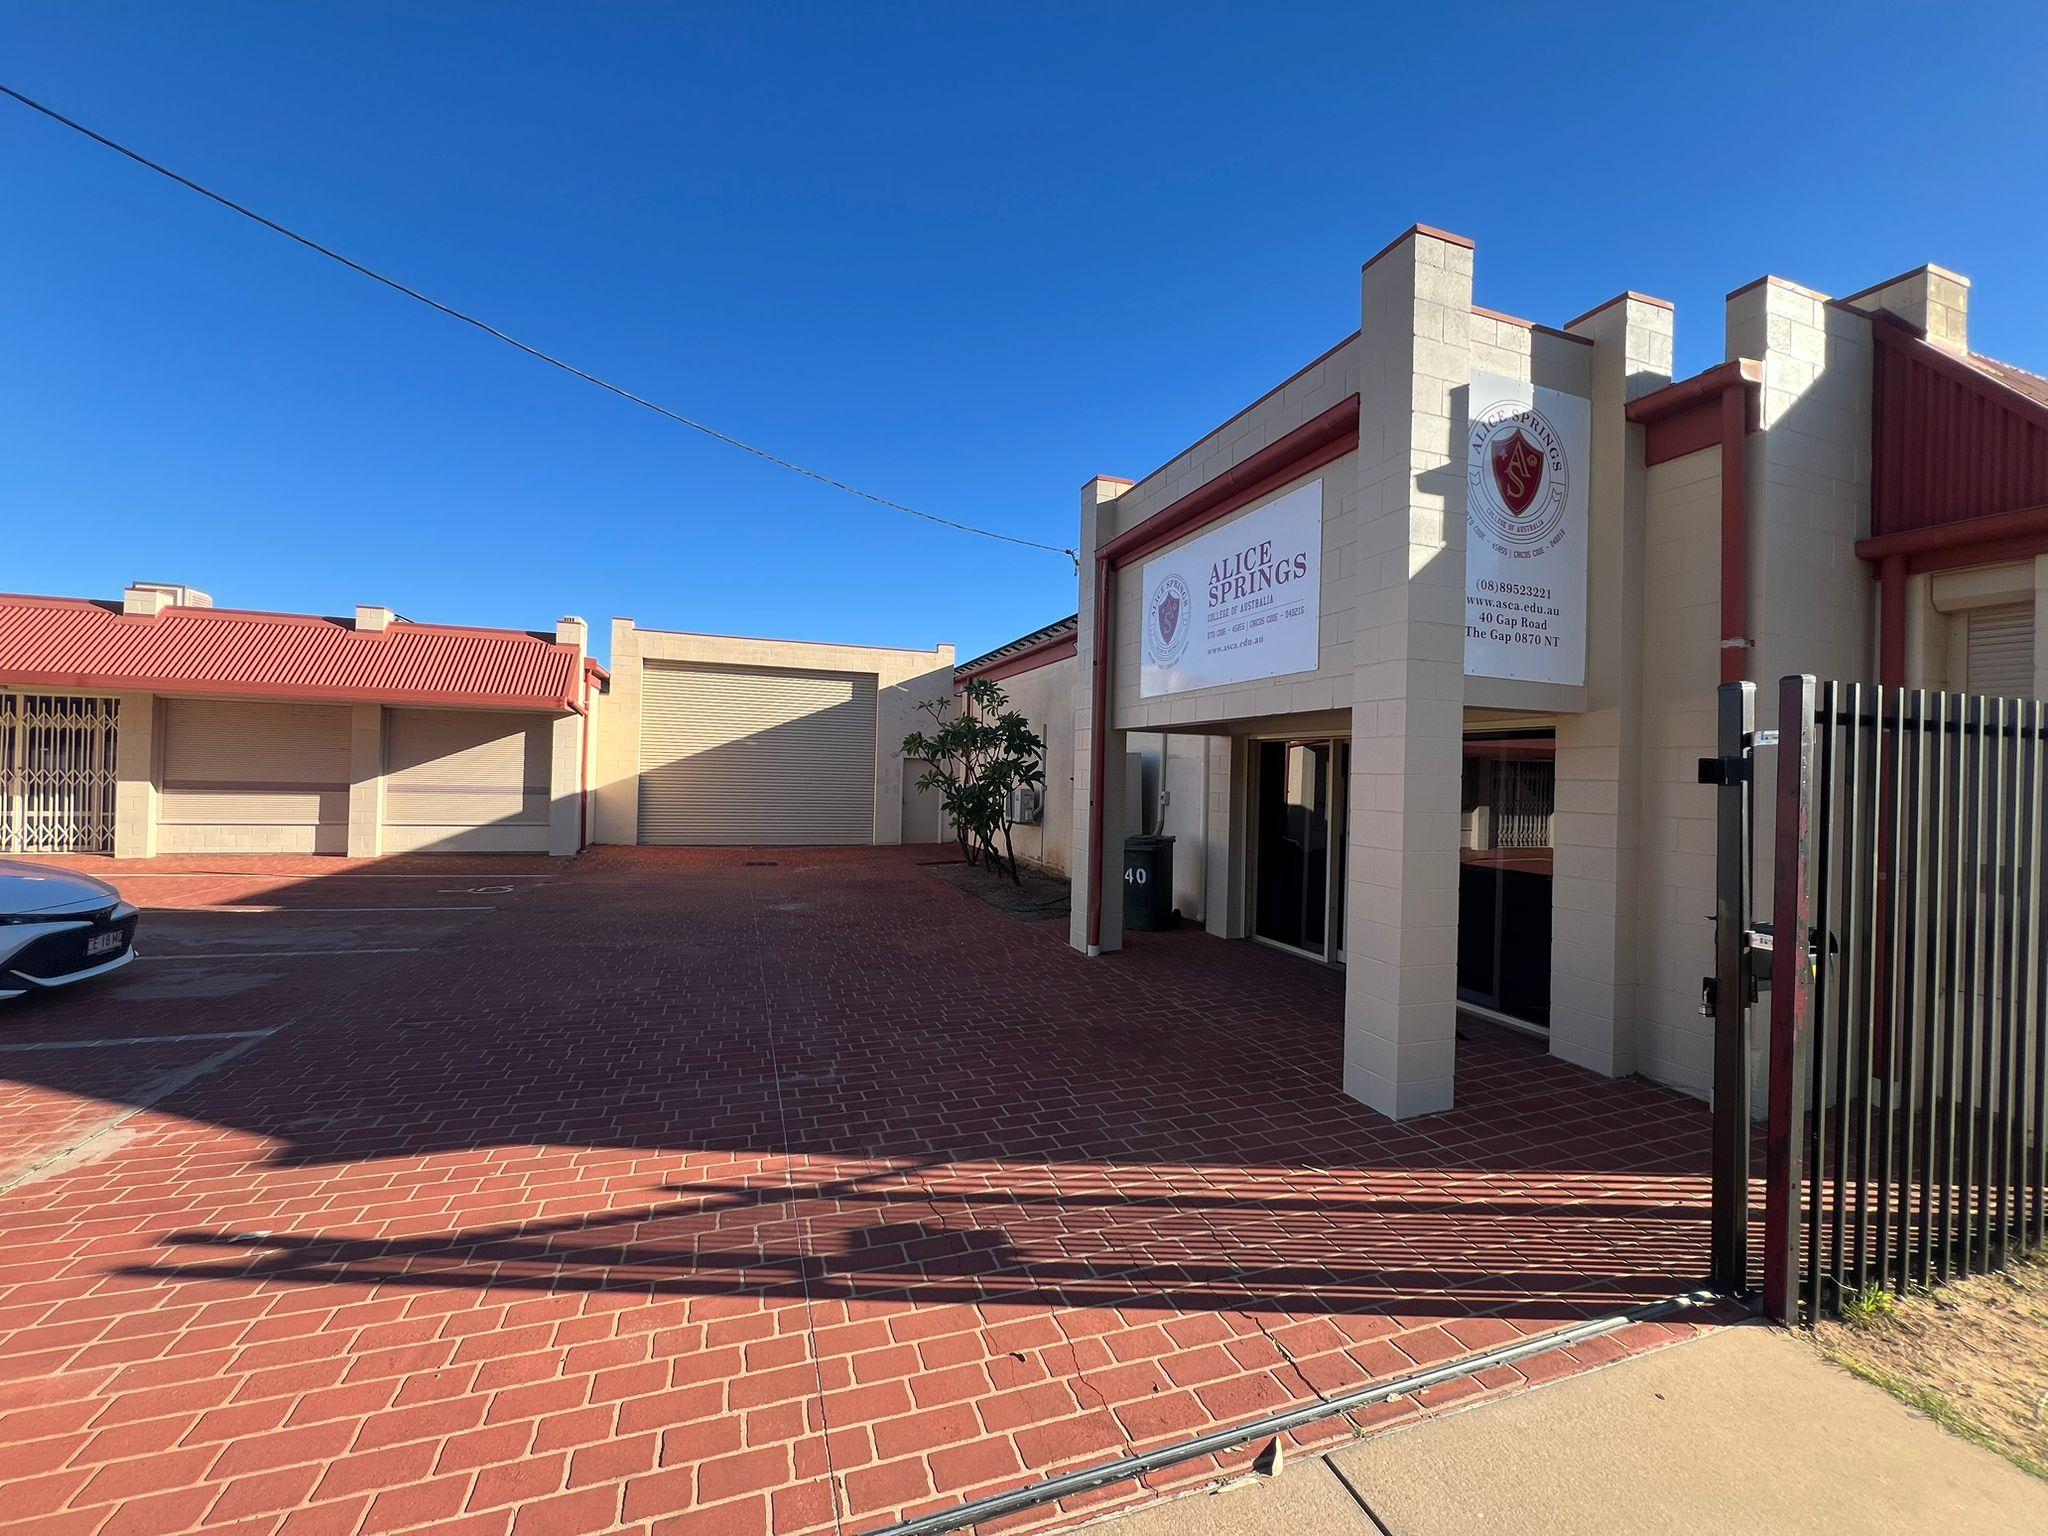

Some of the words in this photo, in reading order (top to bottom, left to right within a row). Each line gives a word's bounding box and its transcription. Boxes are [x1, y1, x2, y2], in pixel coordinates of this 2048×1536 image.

[1472, 410, 1507, 455] ALICE
[1511, 409, 1562, 471] SPRINGS
[1486, 508, 1507, 529] COLLEGE
[1517, 520, 1544, 533] AUSTRALIA
[1532, 546, 1545, 557] CODE
[1208, 540, 1272, 586] ALICE
[1208, 552, 1307, 608] SPRINGS
[1476, 578, 1551, 599] (08)89523221
[1207, 608, 1230, 623] COLLEGE
[1230, 605, 1239, 616] OF
[1240, 594, 1274, 613] AUSTRALIA
[1466, 596, 1560, 616] www.asca.edu.au
[1479, 612, 1493, 623] 40
[1496, 613, 1518, 629] Gap
[1521, 617, 1547, 631] Road
[1207, 636, 1264, 655] www.asca.edu.au
[1465, 625, 1487, 639] The
[1490, 629, 1512, 644] Gap
[1514, 632, 1541, 645] 0870
[1544, 635, 1561, 647] NT
[1125, 868, 1147, 884] 40
